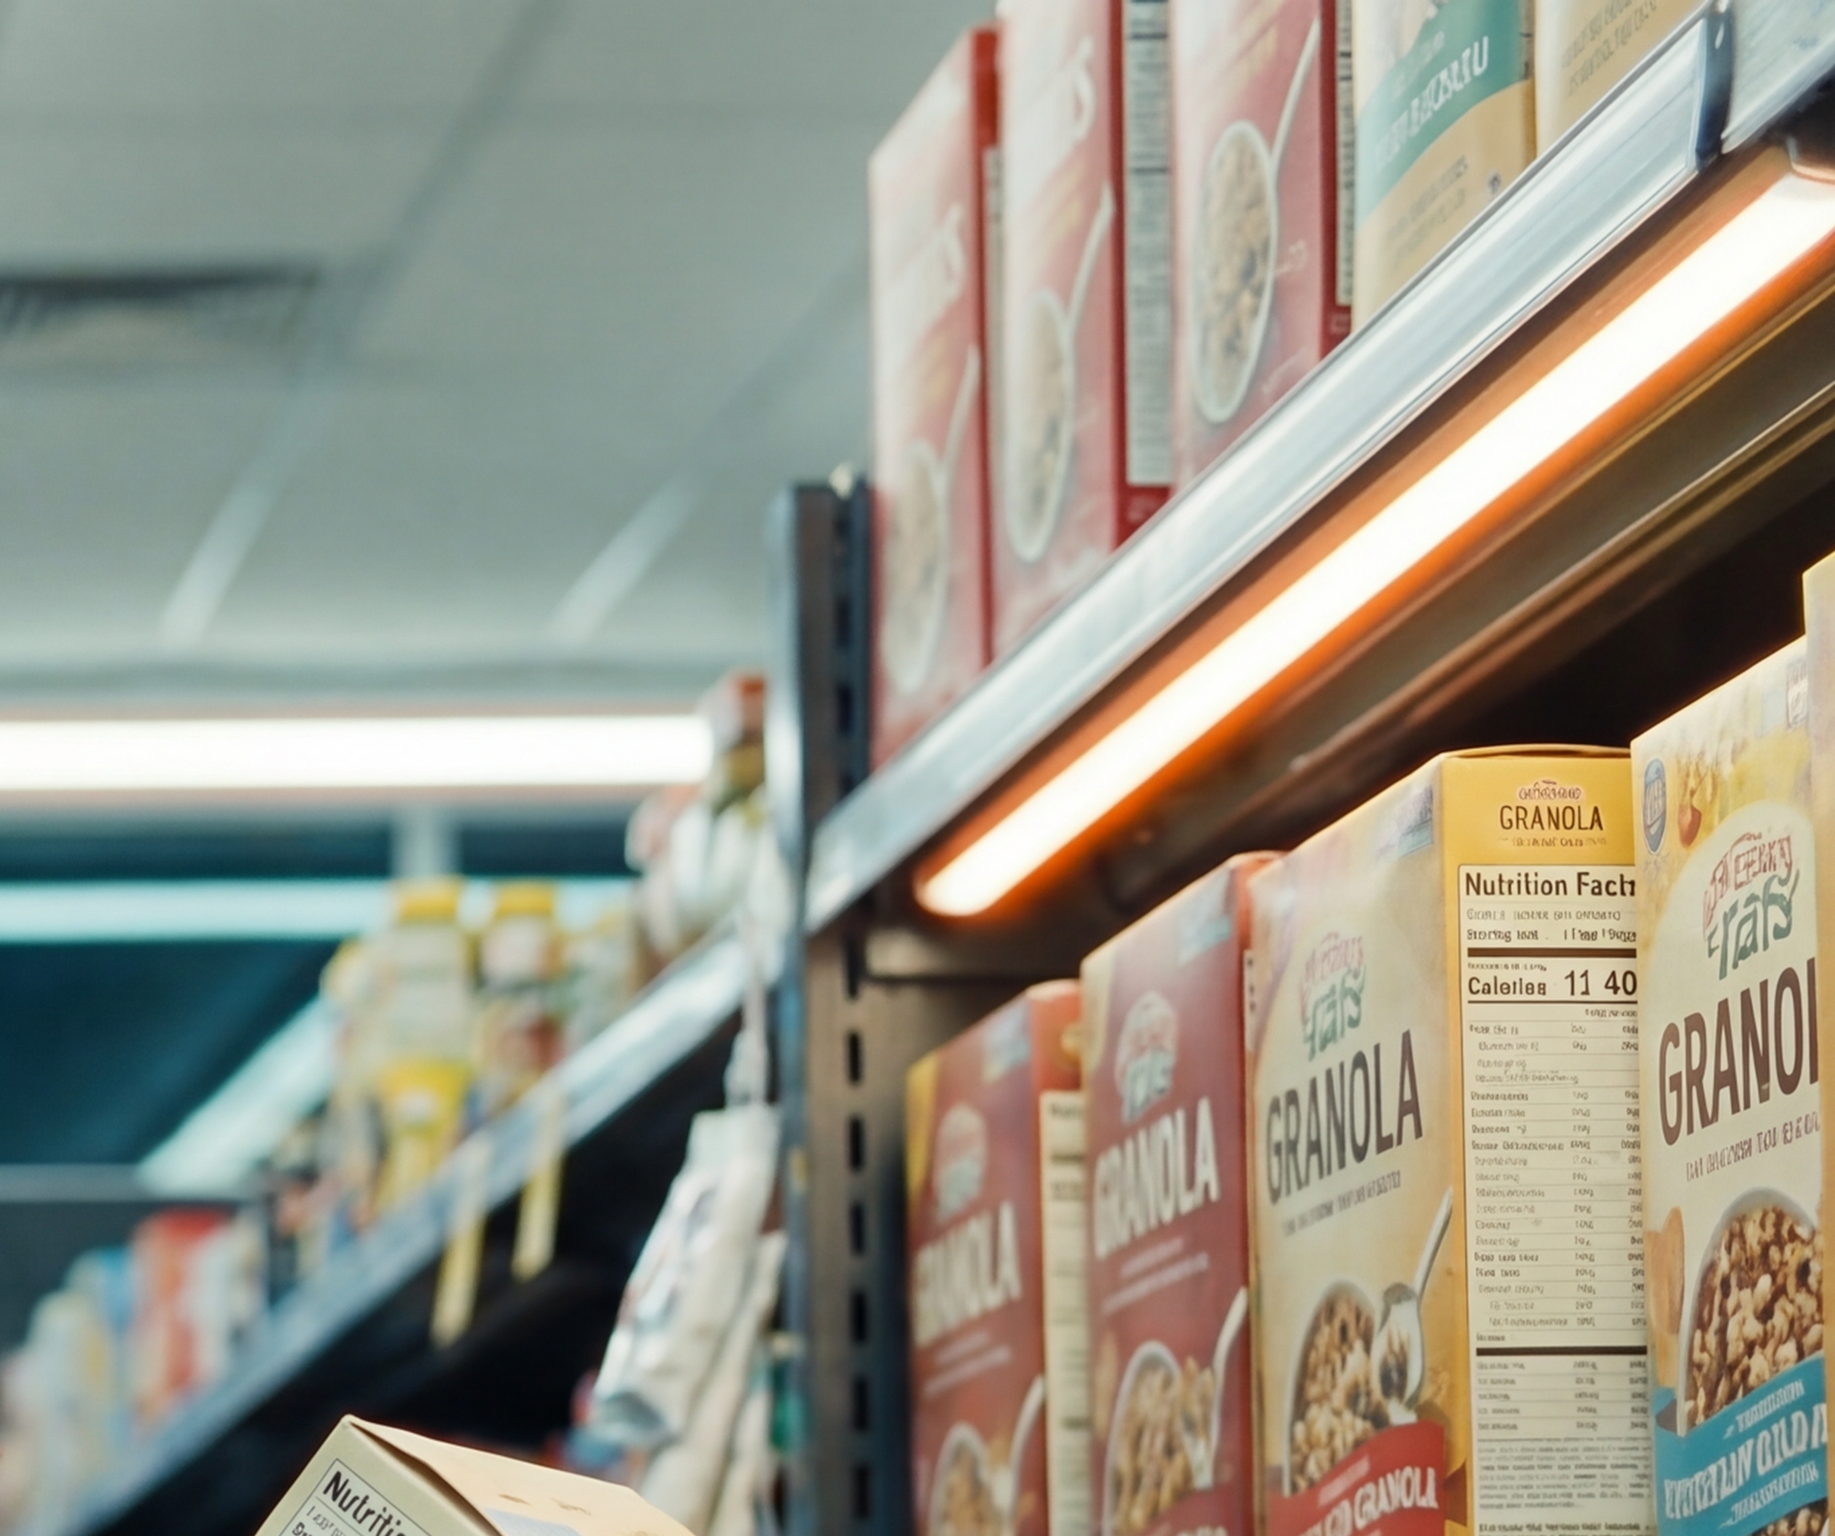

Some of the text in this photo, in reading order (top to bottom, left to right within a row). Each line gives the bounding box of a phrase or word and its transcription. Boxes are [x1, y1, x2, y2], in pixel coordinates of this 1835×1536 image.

[1500, 804, 1604, 831] GRANOLA
[1465, 873, 1568, 897] Nutrition
[1659, 956, 1819, 1147] GRANO
[1266, 1029, 1423, 1206] GRANOLA
